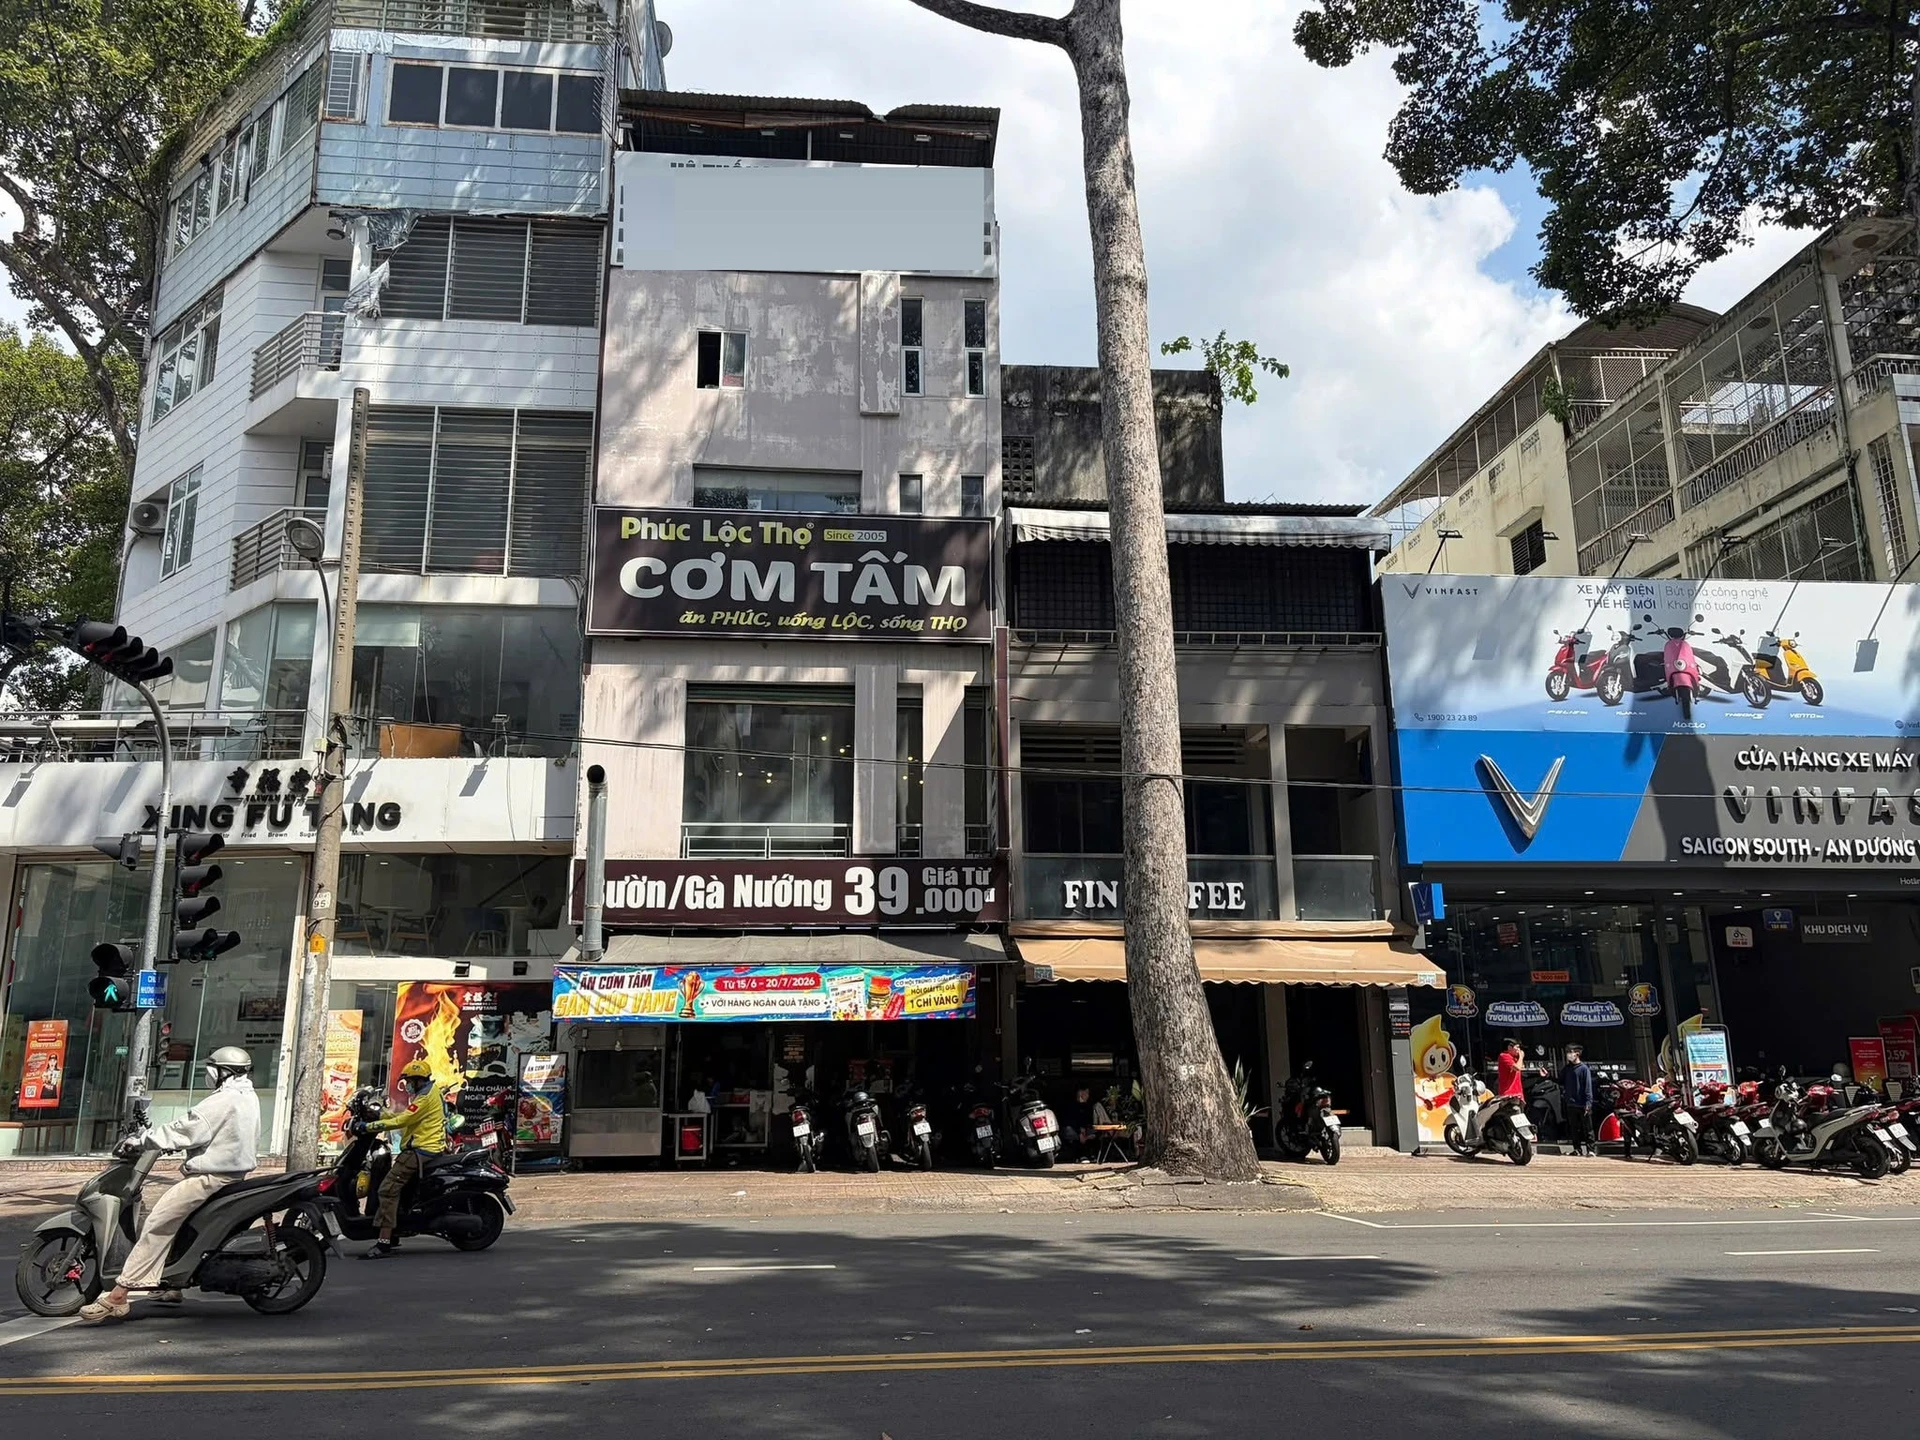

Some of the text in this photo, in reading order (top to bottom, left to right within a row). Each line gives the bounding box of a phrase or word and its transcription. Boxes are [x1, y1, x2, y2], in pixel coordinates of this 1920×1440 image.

[620, 516, 690, 542] Phúc
[702, 519, 752, 548] Lộc
[825, 530, 886, 543] Since 2005
[619, 550, 966, 606] CƠM TẤM
[1425, 587, 1478, 595] VINFAST
[1576, 583, 1655, 597] XE MÁY ĐIỆN
[1665, 585, 1686, 596] Bứt
[1712, 585, 1739, 599] công
[1741, 585, 1769, 599] nghệ
[1585, 598, 1657, 611] THẾ HỆ MỚI
[1695, 600, 1711, 611] mở
[1715, 601, 1747, 613] tương
[1749, 601, 1762, 611] lai
[678, 607, 968, 632] ăn PHÚC, uống LỘC, sống THỌ
[1468, 714, 1478, 722] 89
[1737, 744, 1915, 768] CỬA HÀNG XE MÁY
[246, 803, 292, 828] FU
[304, 802, 401, 829] TNG
[1681, 837, 1748, 855] SAIGON
[1753, 838, 1811, 856] SOUTH
[1827, 838, 1851, 856] AN
[922, 865, 992, 887] Giá Từ
[601, 874, 724, 911] ườn/Gà
[732, 873, 832, 911] Nướng
[844, 866, 909, 917] 39
[1063, 880, 1118, 909] FIN
[313, 900, 326, 908] 95
[1804, 925, 1825, 934] KHU
[1828, 924, 1851, 936] DỊCH
[1854, 924, 1868, 936] VỤ
[580, 969, 653, 990] ĂN CƠM TẤM
[723, 978, 736, 989] Từ
[736, 978, 758, 989] 15/6
[765, 976, 816, 989] 20/7/2026
[711, 997, 726, 1007] VỚI
[727, 998, 751, 1007] HÀNG
[778, 997, 796, 1007] QUÀ
[798, 999, 820, 1009] TẶNG
[916, 995, 932, 1008] CHỈ
[933, 994, 959, 1006] VÀNG
